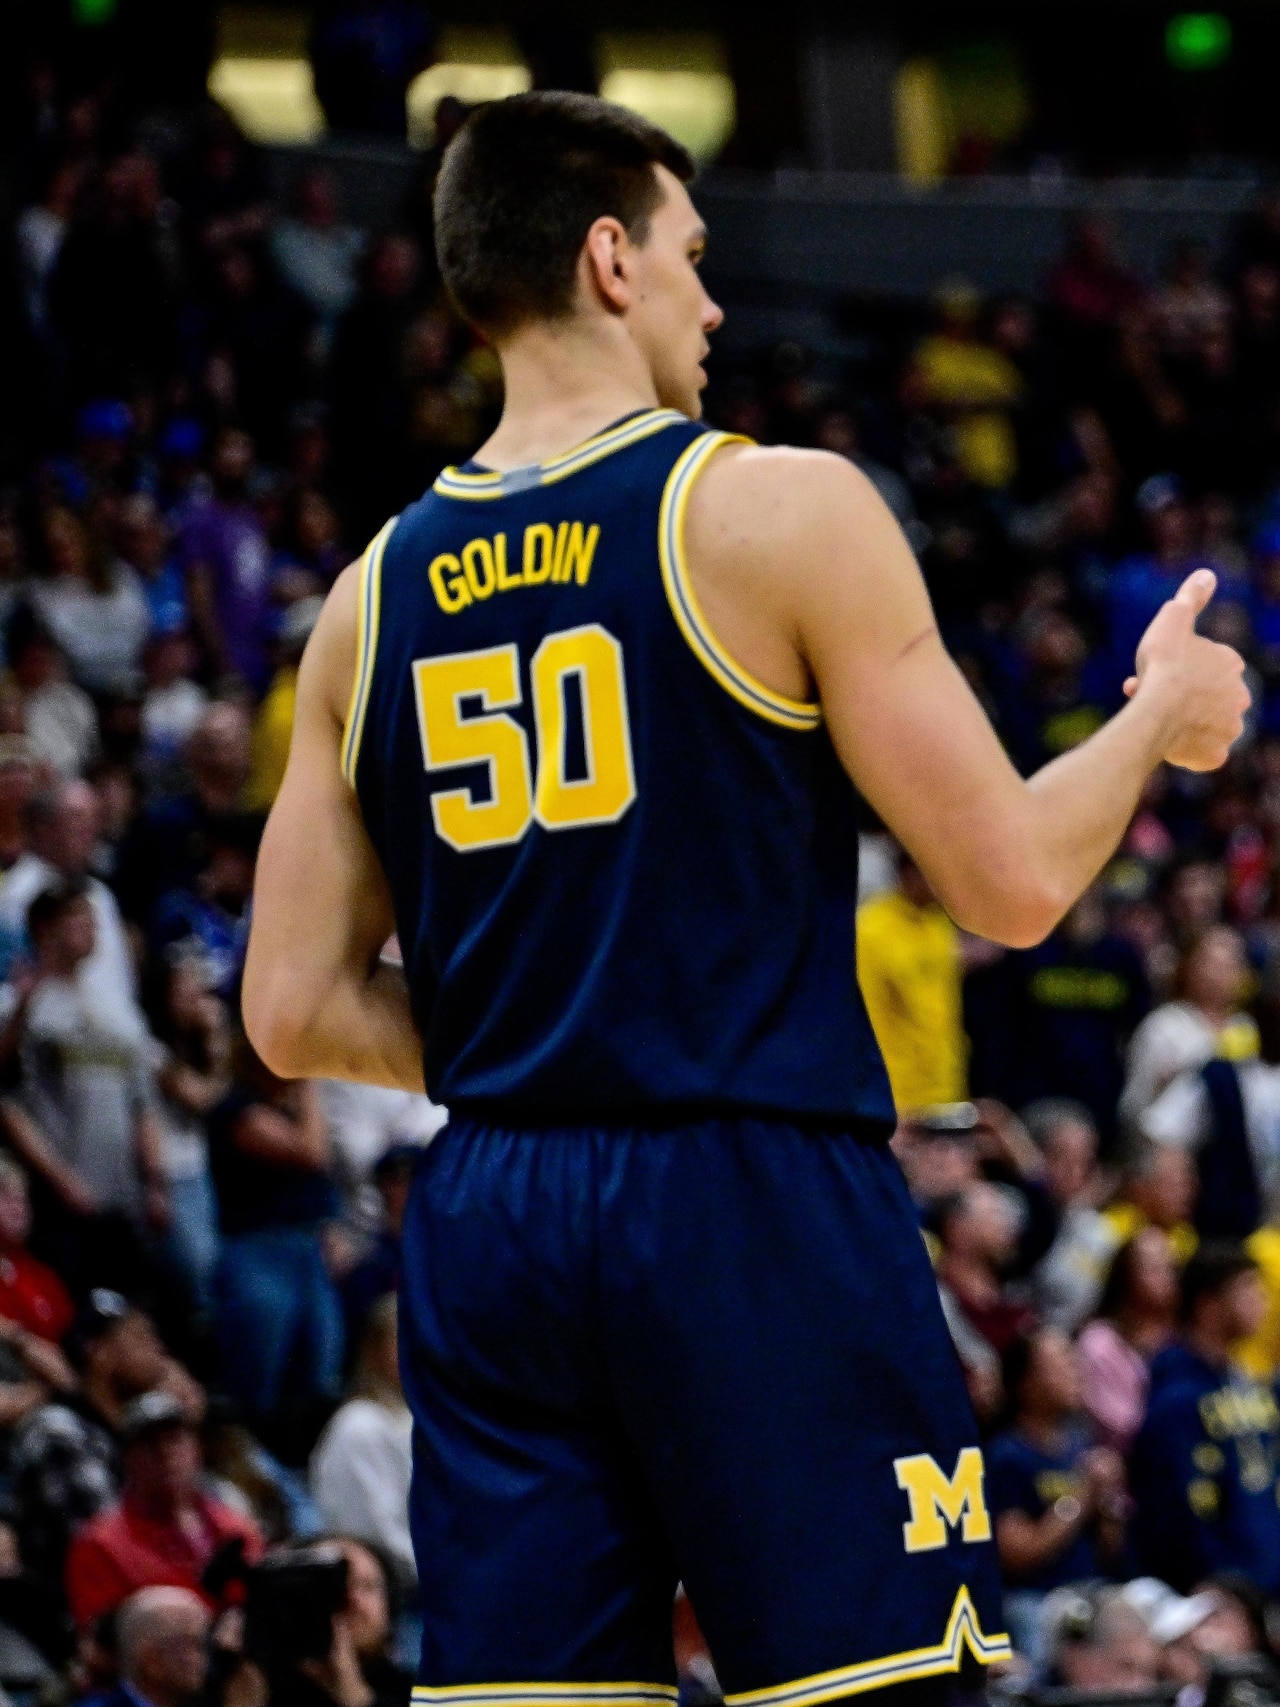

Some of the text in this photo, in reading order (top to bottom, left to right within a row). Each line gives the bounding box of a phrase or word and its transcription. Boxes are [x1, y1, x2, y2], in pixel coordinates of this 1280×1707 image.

[428, 521, 599, 614] GOLDIN
[412, 622, 637, 853] 50
[893, 1446, 992, 1554] M
